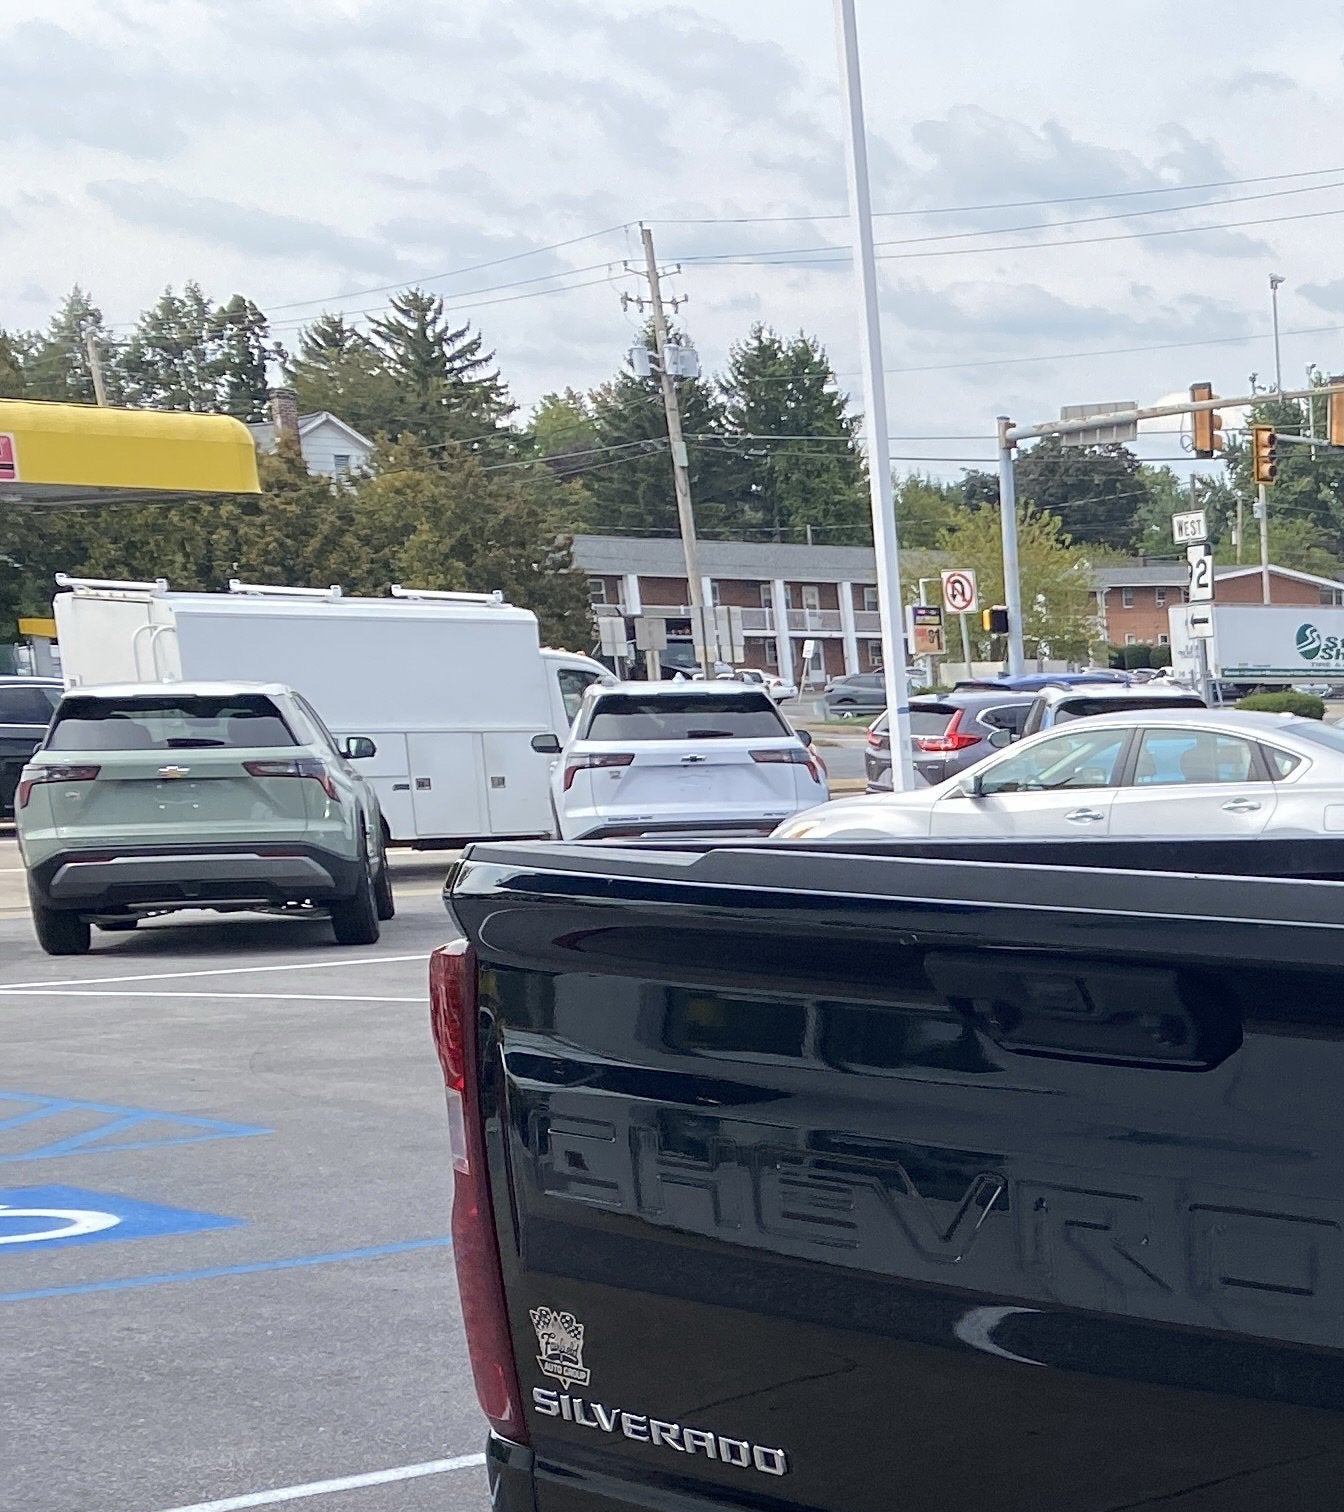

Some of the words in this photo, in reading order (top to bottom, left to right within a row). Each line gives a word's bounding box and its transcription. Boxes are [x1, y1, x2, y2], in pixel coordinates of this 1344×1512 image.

[1176, 519, 1202, 538] WEST
[544, 1361, 562, 1374] AUTO
[563, 1366, 587, 1381] GROUP
[532, 1387, 788, 1477] SILVERADO
